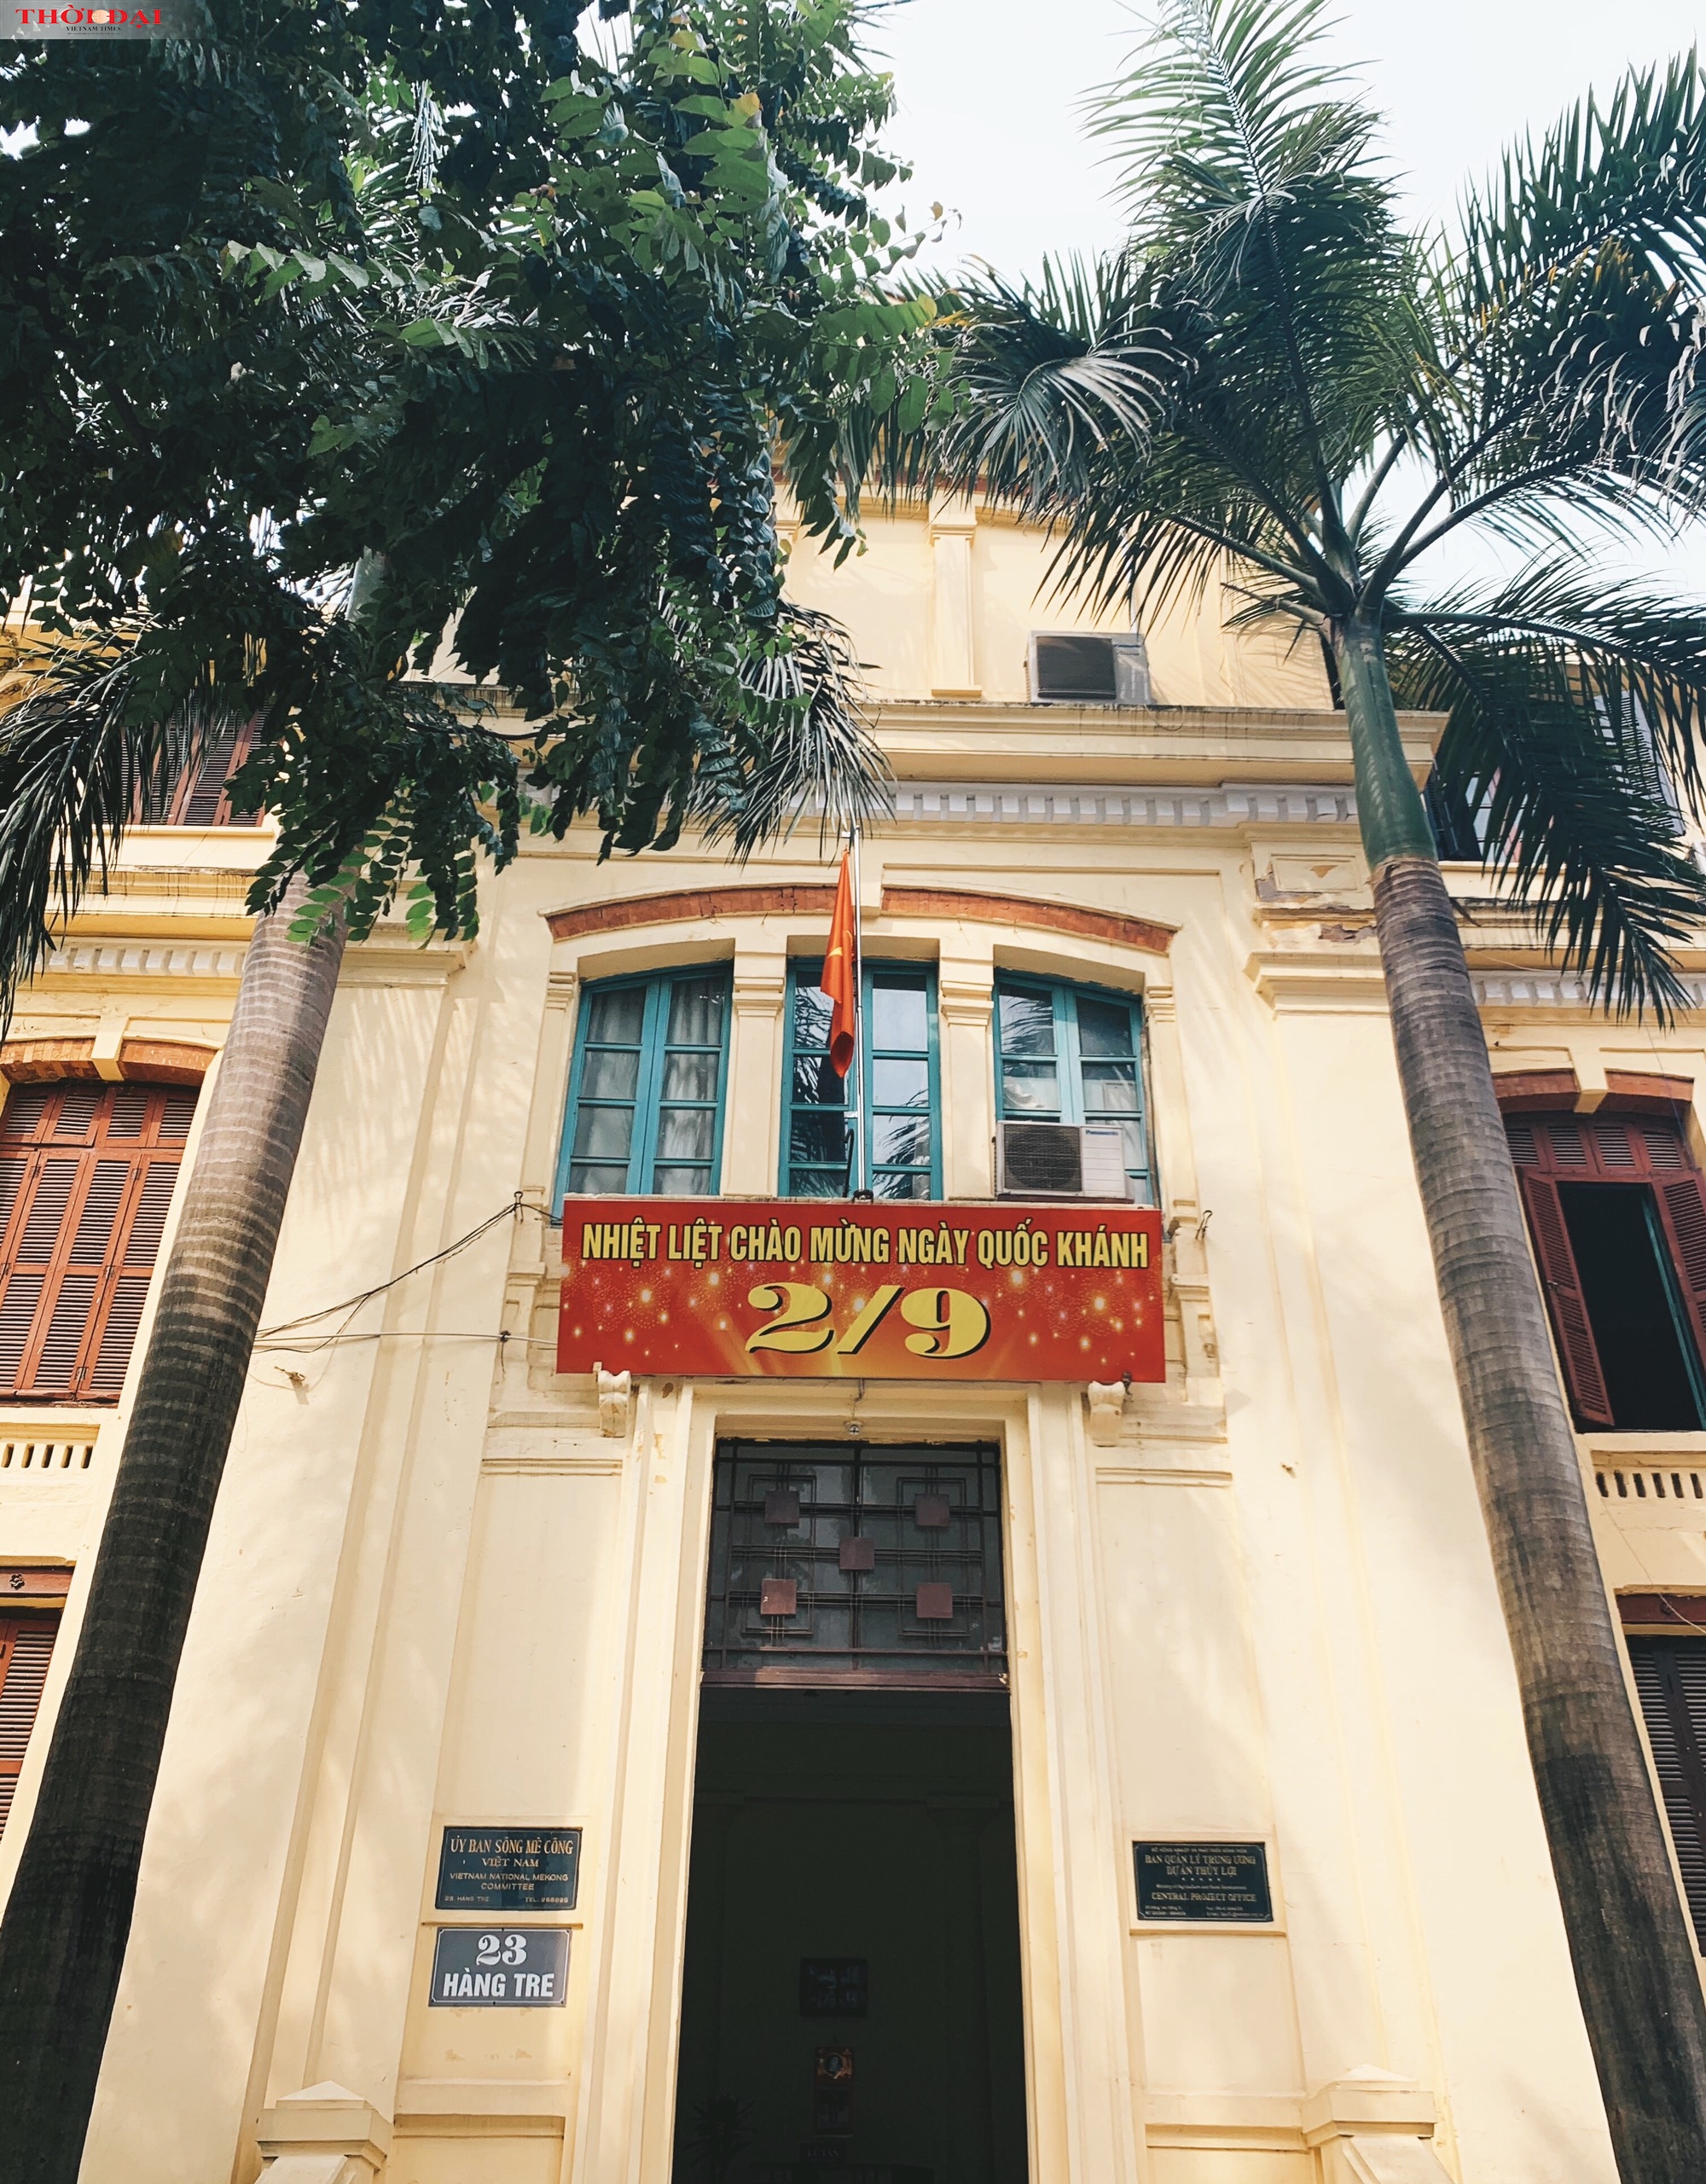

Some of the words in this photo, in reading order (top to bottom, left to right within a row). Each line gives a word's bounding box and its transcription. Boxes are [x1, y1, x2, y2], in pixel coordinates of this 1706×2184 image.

[582, 1217, 661, 1268] NHIỆT
[668, 1217, 722, 1269] LIỆT
[730, 1219, 801, 1262] CHÀO
[810, 1218, 890, 1263] MỪNG
[898, 1222, 970, 1264] NGÀY
[978, 1218, 1049, 1269] QUỐC
[1057, 1225, 1148, 1269] KHÁNH
[745, 1281, 991, 1359] 2/9
[468, 1838, 492, 1853] BAN
[495, 1836, 523, 1854] SÔNG
[514, 1858, 539, 1867] NAM
[1145, 1855, 1163, 1863] BAN
[489, 1873, 530, 1881] NATIONAL
[532, 1873, 568, 1882] MEKONG
[1152, 1892, 1188, 1901] CENTRAL
[1190, 1892, 1227, 1902] PROJECT
[1227, 1893, 1257, 1902] OFFICE
[475, 1934, 528, 1966] 23
[443, 1967, 507, 1997] HÀNG
[514, 1973, 554, 1997] TRE
